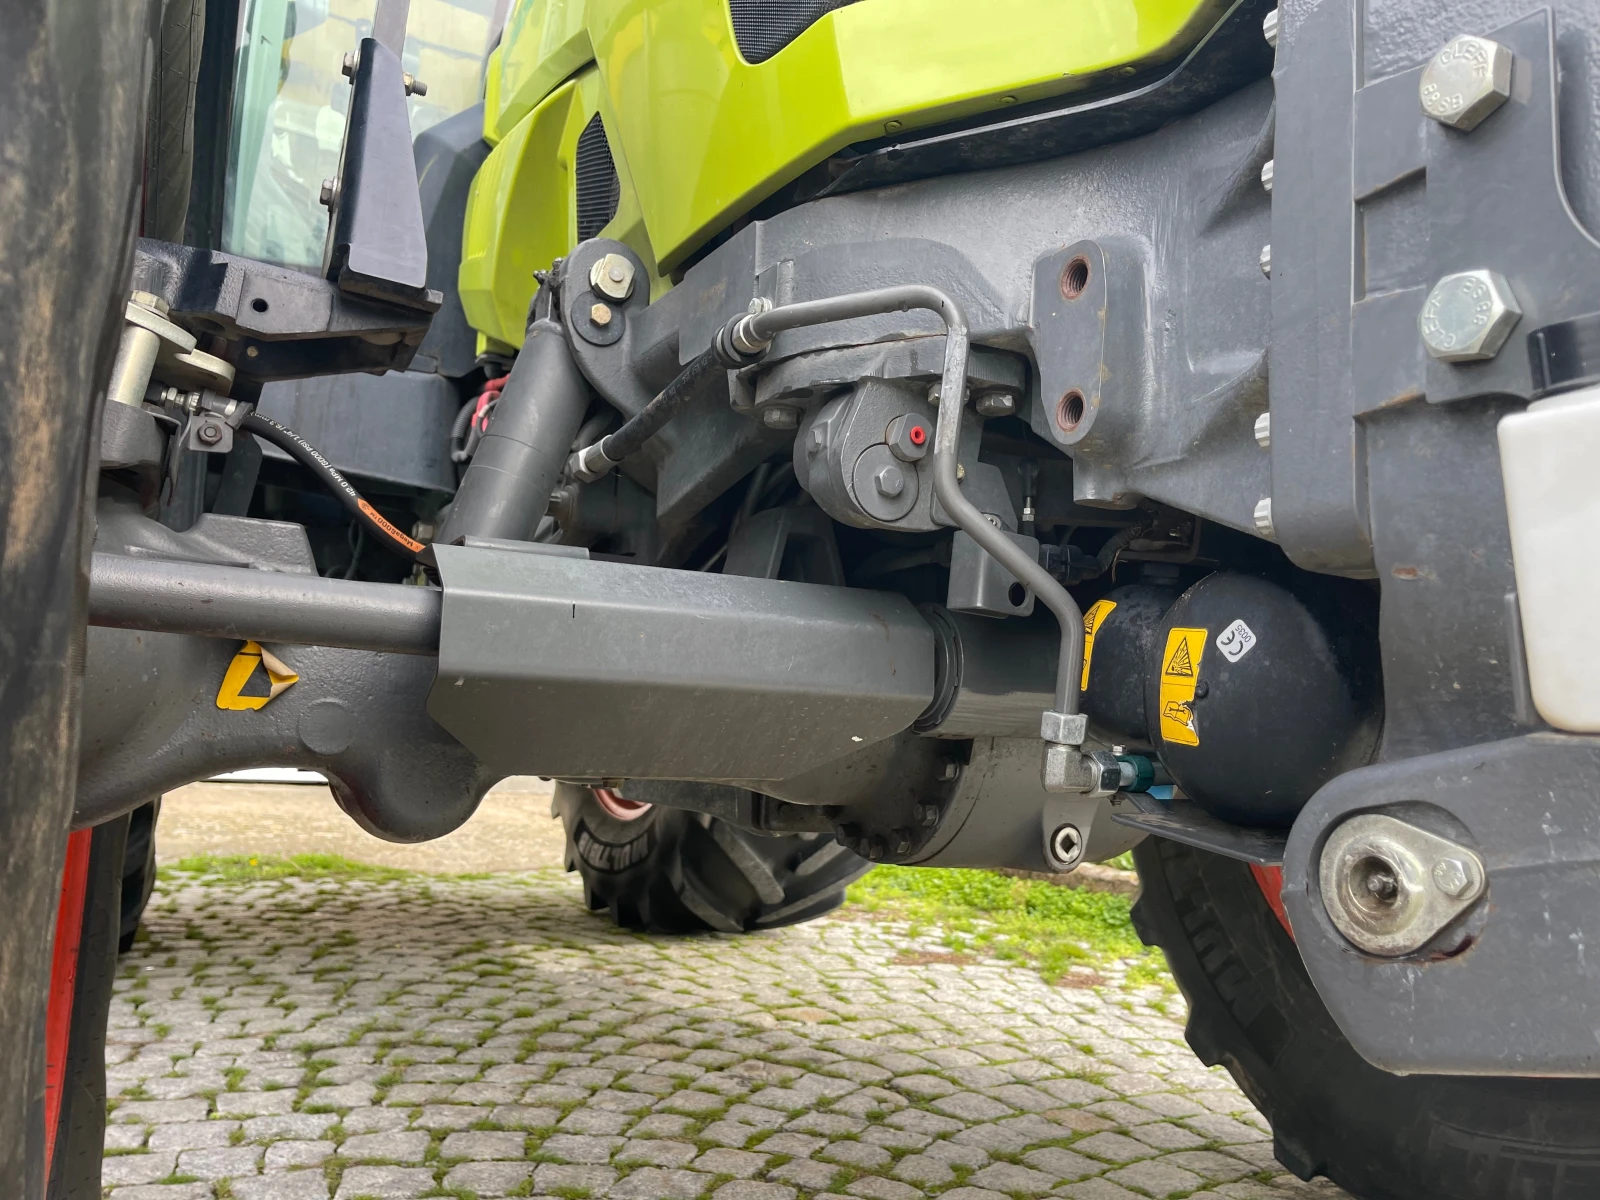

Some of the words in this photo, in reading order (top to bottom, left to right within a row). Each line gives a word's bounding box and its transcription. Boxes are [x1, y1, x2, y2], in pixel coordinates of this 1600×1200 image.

[329, 468, 344, 482] MPa
[341, 480, 356, 497] 42.0
[1220, 629, 1244, 656] CE
[1234, 624, 1252, 643] 0035
